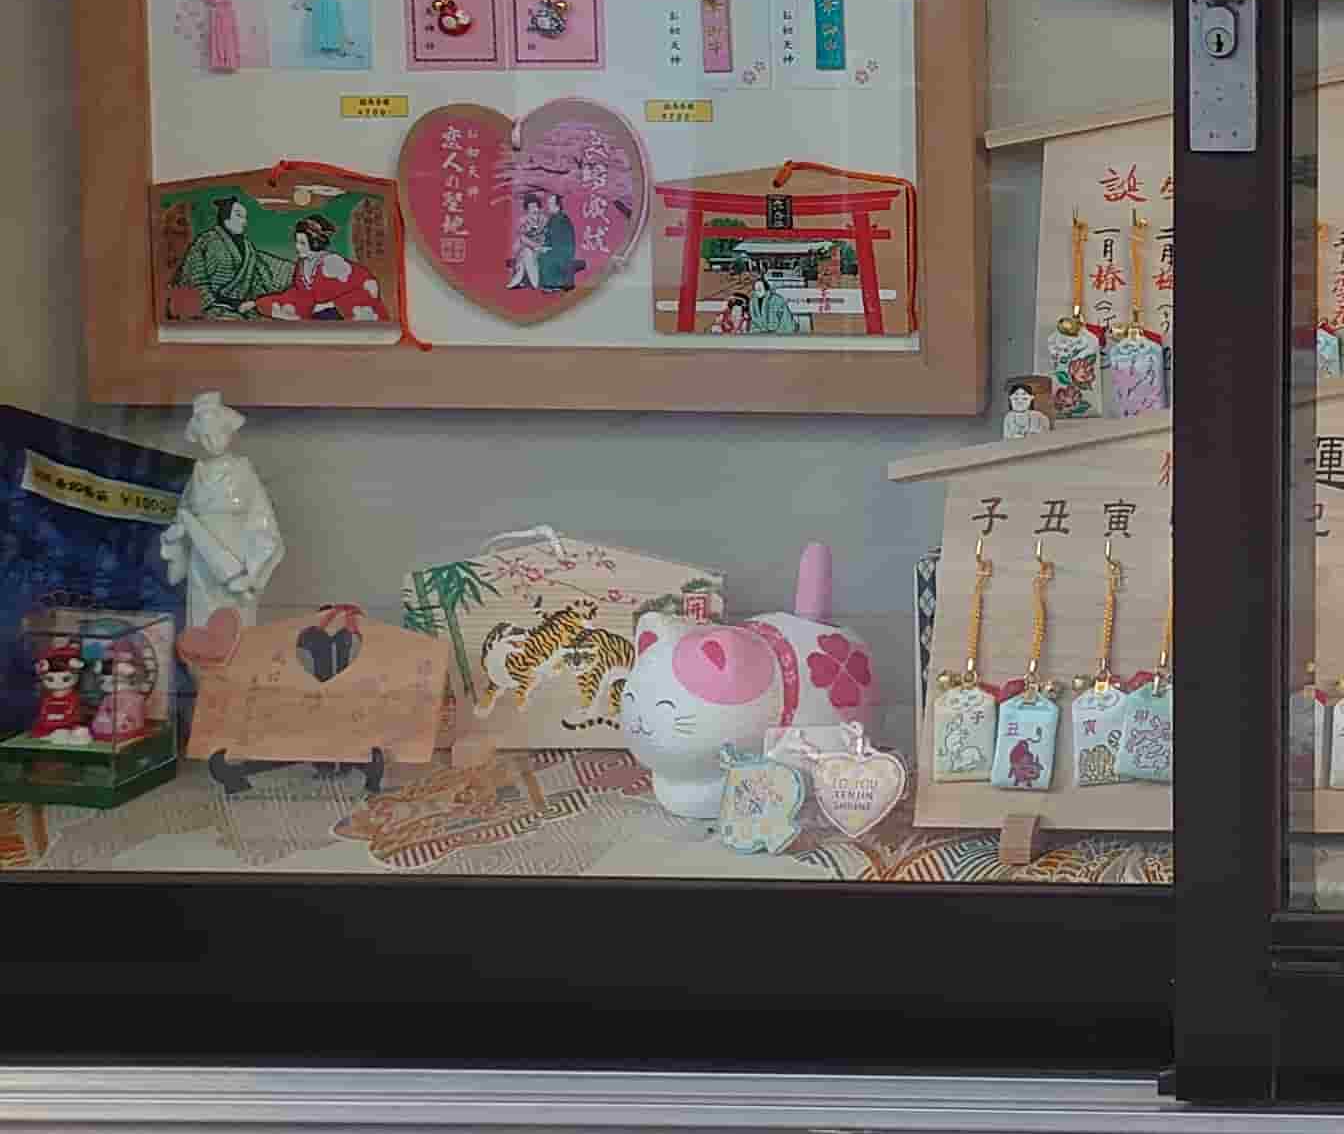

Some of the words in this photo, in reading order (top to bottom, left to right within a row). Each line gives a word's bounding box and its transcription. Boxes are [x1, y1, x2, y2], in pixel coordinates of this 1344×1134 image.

[971, 497, 1009, 538] 子
[1039, 498, 1074, 537] 丑
[1103, 498, 1138, 540] 寅
